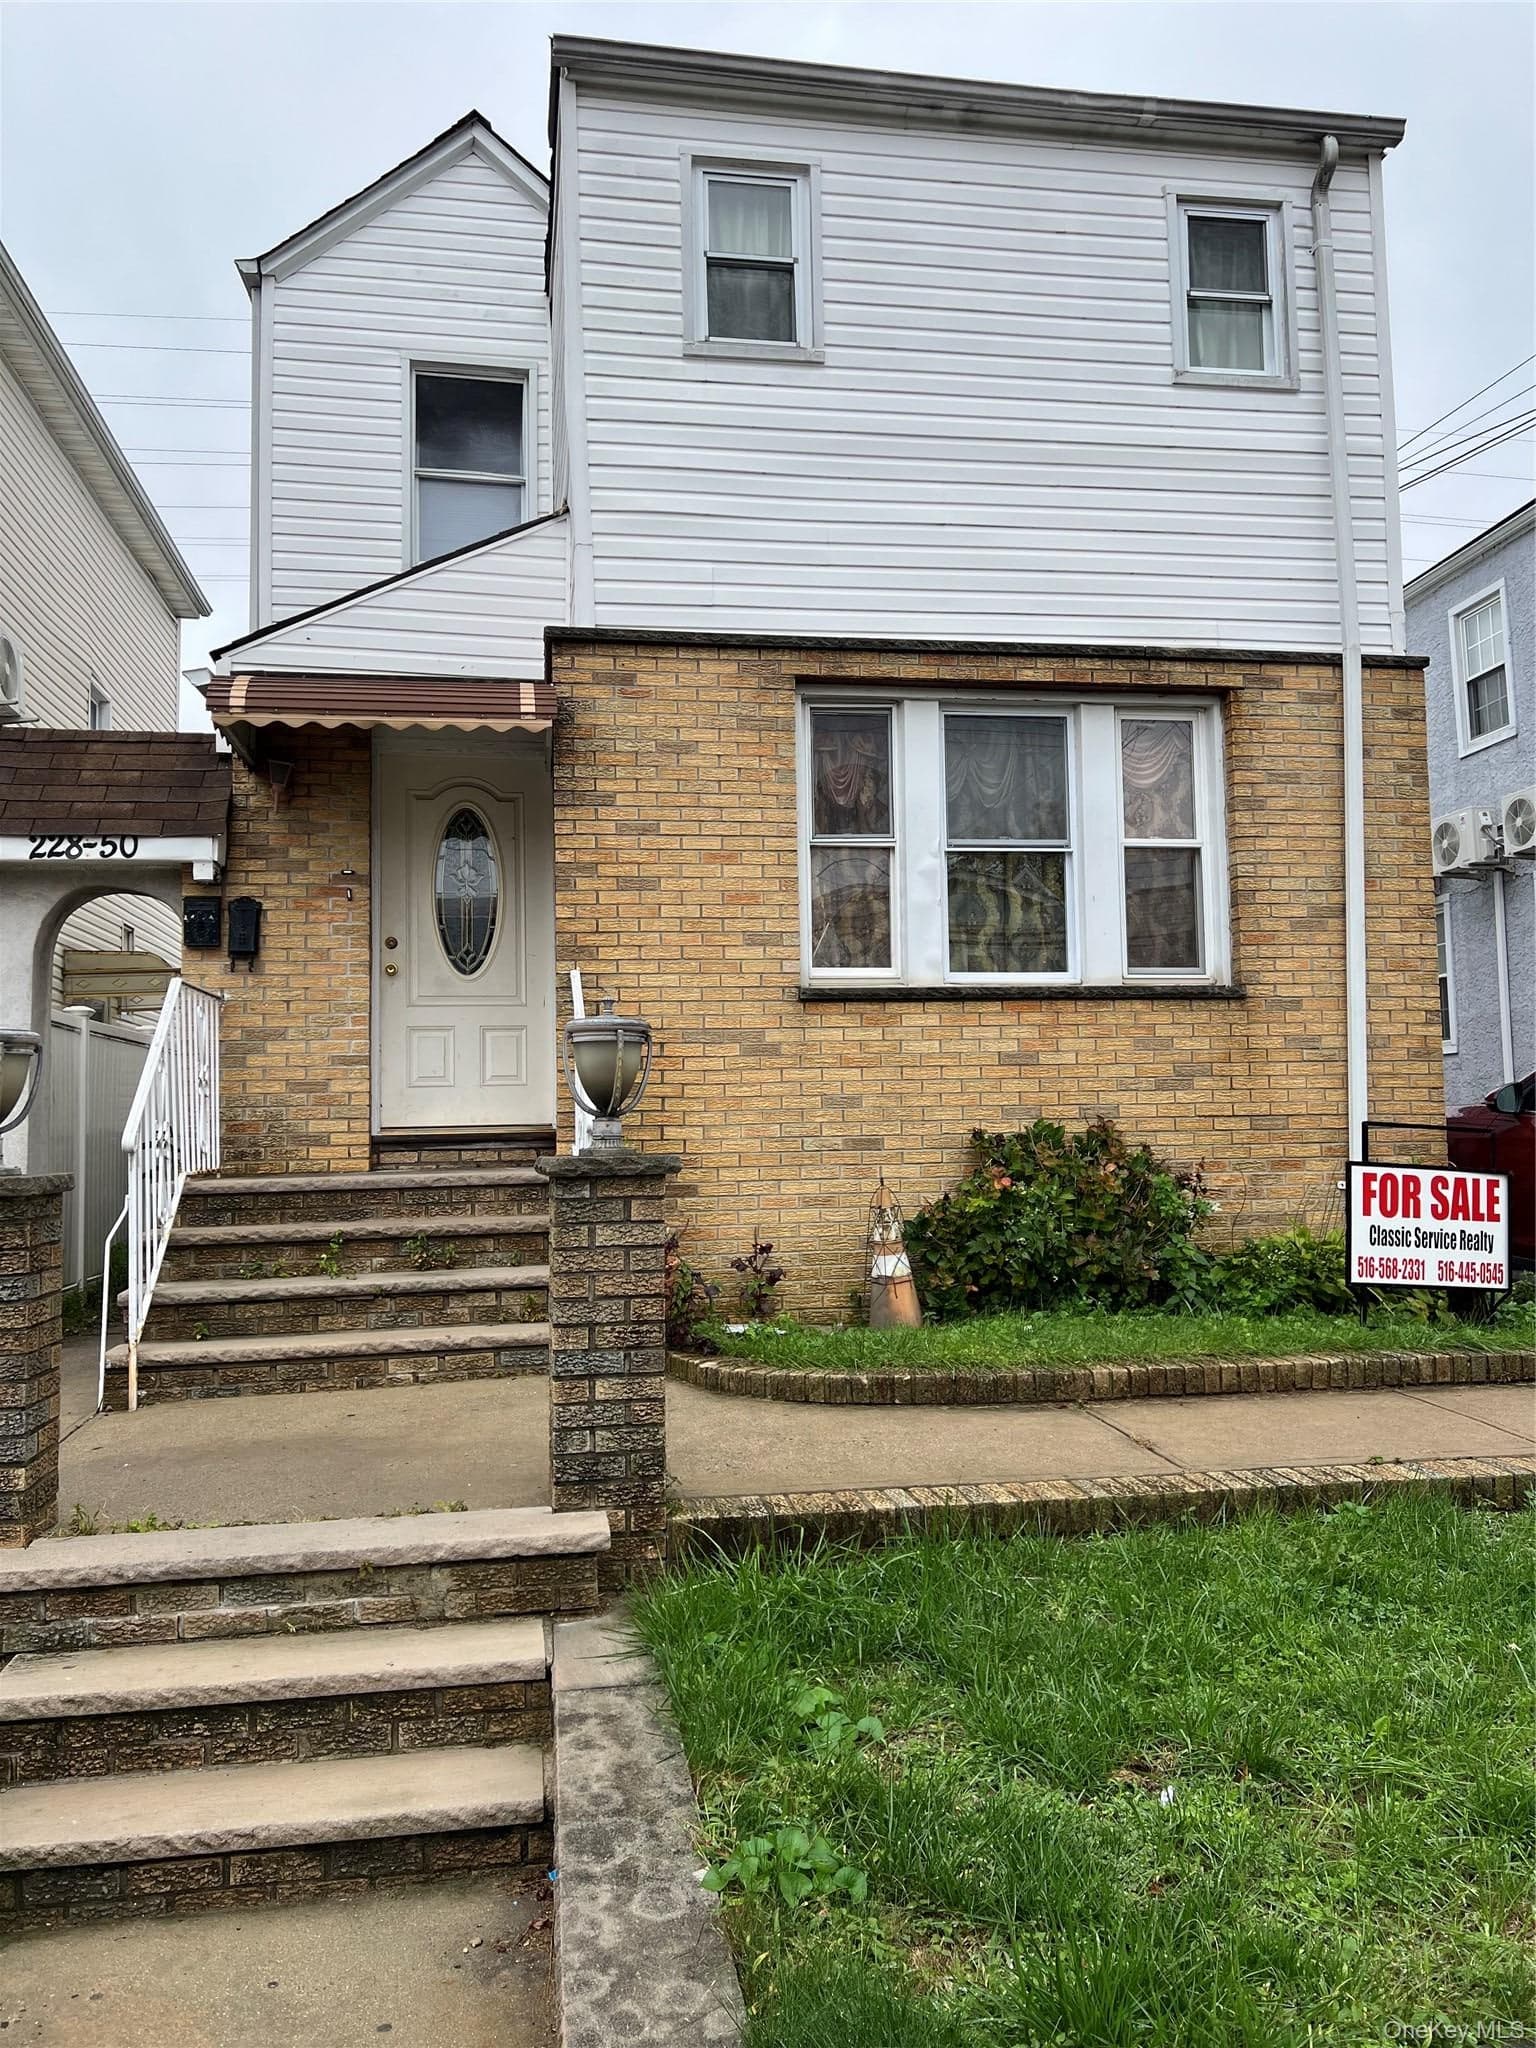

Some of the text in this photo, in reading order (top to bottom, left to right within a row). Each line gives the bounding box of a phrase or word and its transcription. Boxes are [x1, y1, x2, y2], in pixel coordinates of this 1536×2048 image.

[28, 834, 139, 860] 228-50
[1362, 1172, 1501, 1223] FOR SALE
[1369, 1224, 1494, 1254] Classic Service Realty
[1357, 1256, 1504, 1285] 516-568-2331 516-445-0545
